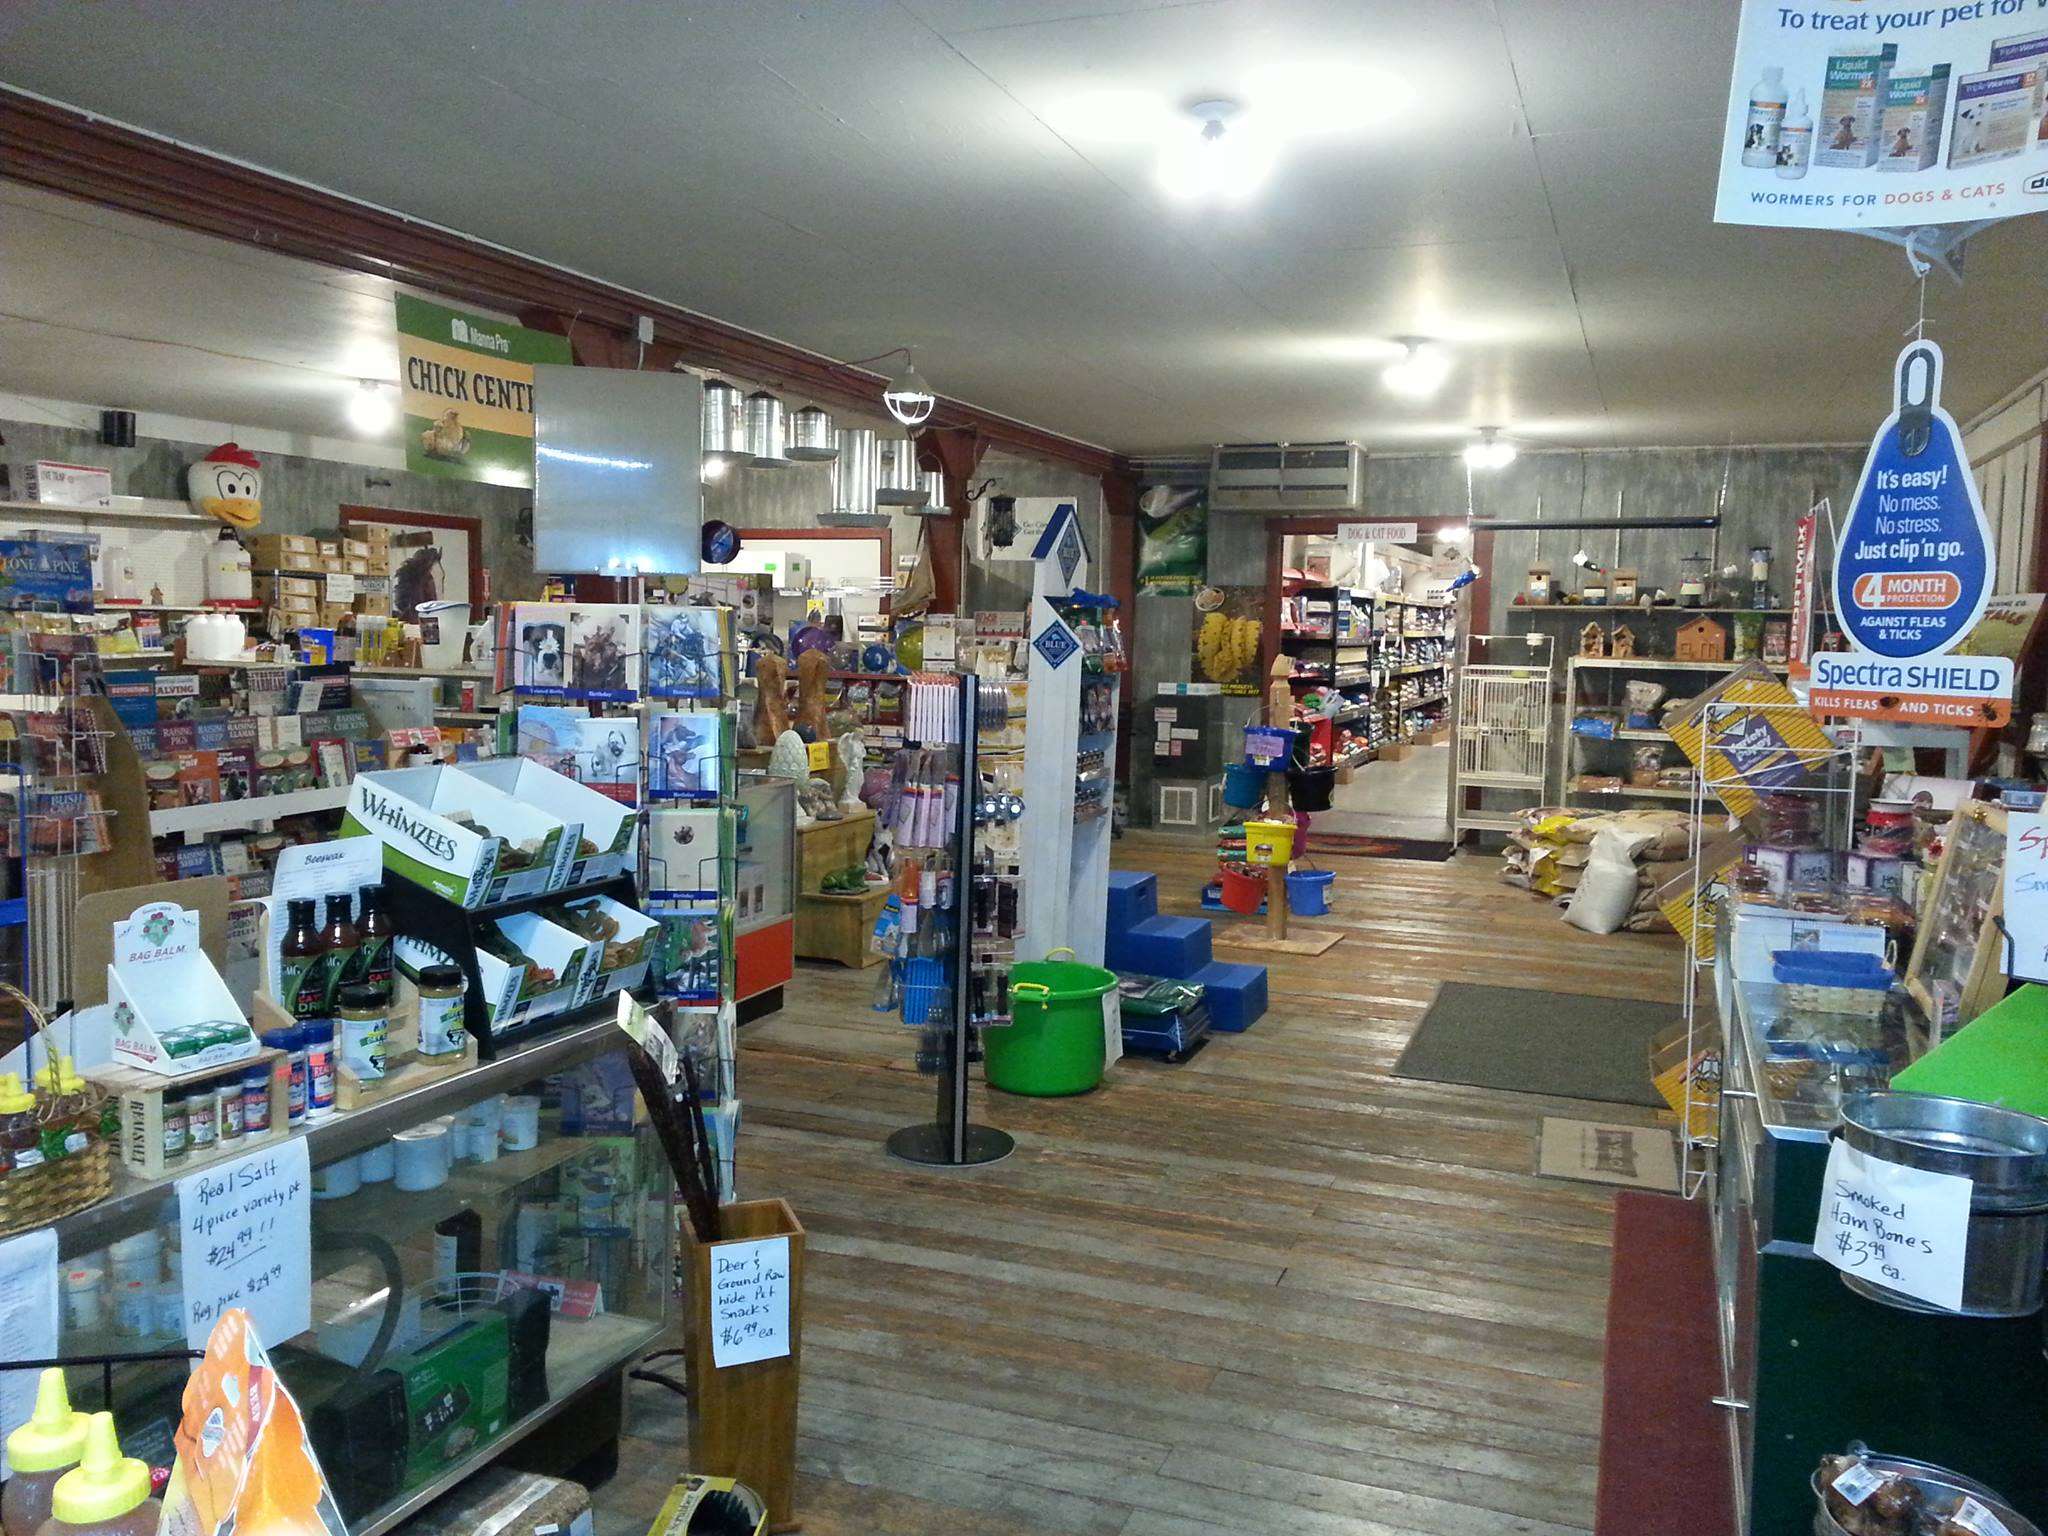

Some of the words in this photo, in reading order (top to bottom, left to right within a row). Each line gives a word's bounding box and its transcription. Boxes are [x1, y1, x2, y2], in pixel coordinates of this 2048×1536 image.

[1778, 8, 1805, 28] To
[1812, 11, 1868, 30] treat
[1876, 9, 1935, 34] your
[1940, 4, 1982, 28] pet
[1836, 59, 1868, 72] Liquid
[1829, 69, 1874, 81] Wormer
[1889, 89, 1926, 100] Wormer
[1894, 80, 1921, 92] Liquid
[1750, 191, 1834, 206] WORMERS
[1842, 193, 1877, 206] FOR
[1884, 190, 1935, 206] DOGS
[1941, 188, 1953, 201] &
[1960, 183, 2005, 199] CATS
[407, 356, 468, 401] CHICK
[1877, 469, 1900, 490] It's
[1902, 465, 1947, 491] easy!
[1879, 495, 1898, 513] No
[1900, 498, 1941, 512] mess.
[1347, 527, 1362, 539] DOG
[1372, 527, 1385, 539] CAT
[1387, 527, 1406, 539] FOOD
[1876, 516, 1895, 534] No
[1897, 517, 1942, 533] stress.
[1855, 541, 1887, 561] Just
[1889, 538, 1918, 562] clip
[1938, 542, 1965, 562] go.
[1861, 573, 1885, 608] 4
[1888, 579, 1946, 593] MONTH
[1886, 594, 1945, 603] PROTECTION
[1861, 616, 1907, 628] AGAINST
[1909, 616, 1946, 628] FLEAS
[1879, 629, 1889, 640] &
[1890, 629, 1922, 640] TICKS
[1044, 640, 1066, 648] BLUE
[1814, 696, 1841, 708] KILLS
[1844, 697, 1878, 711] FLEAS
[1900, 701, 1930, 714] AND
[1933, 703, 1975, 717] TICKS
[162, 728, 192, 737] RAISING
[361, 786, 457, 861] WHIMZEES
[129, 952, 151, 962] BAG
[154, 945, 186, 958] BALM
[130, 1100, 145, 1166] REALSALT
[197, 1173, 232, 1205] Real
[238, 1159, 278, 1188] Salt
[1835, 1179, 1905, 1221] Smoked
[193, 1215, 203, 1235] 4
[206, 1207, 239, 1235] piece
[243, 1189, 286, 1216] variety
[1831, 1201, 1869, 1233] Ham
[1873, 1217, 1934, 1255] Bones
[718, 1257, 747, 1275] Deer
[717, 1273, 762, 1290] Ground
[766, 1269, 786, 1283] Raw
[718, 1290, 748, 1306] hide
[721, 1304, 770, 1320] Snacks
